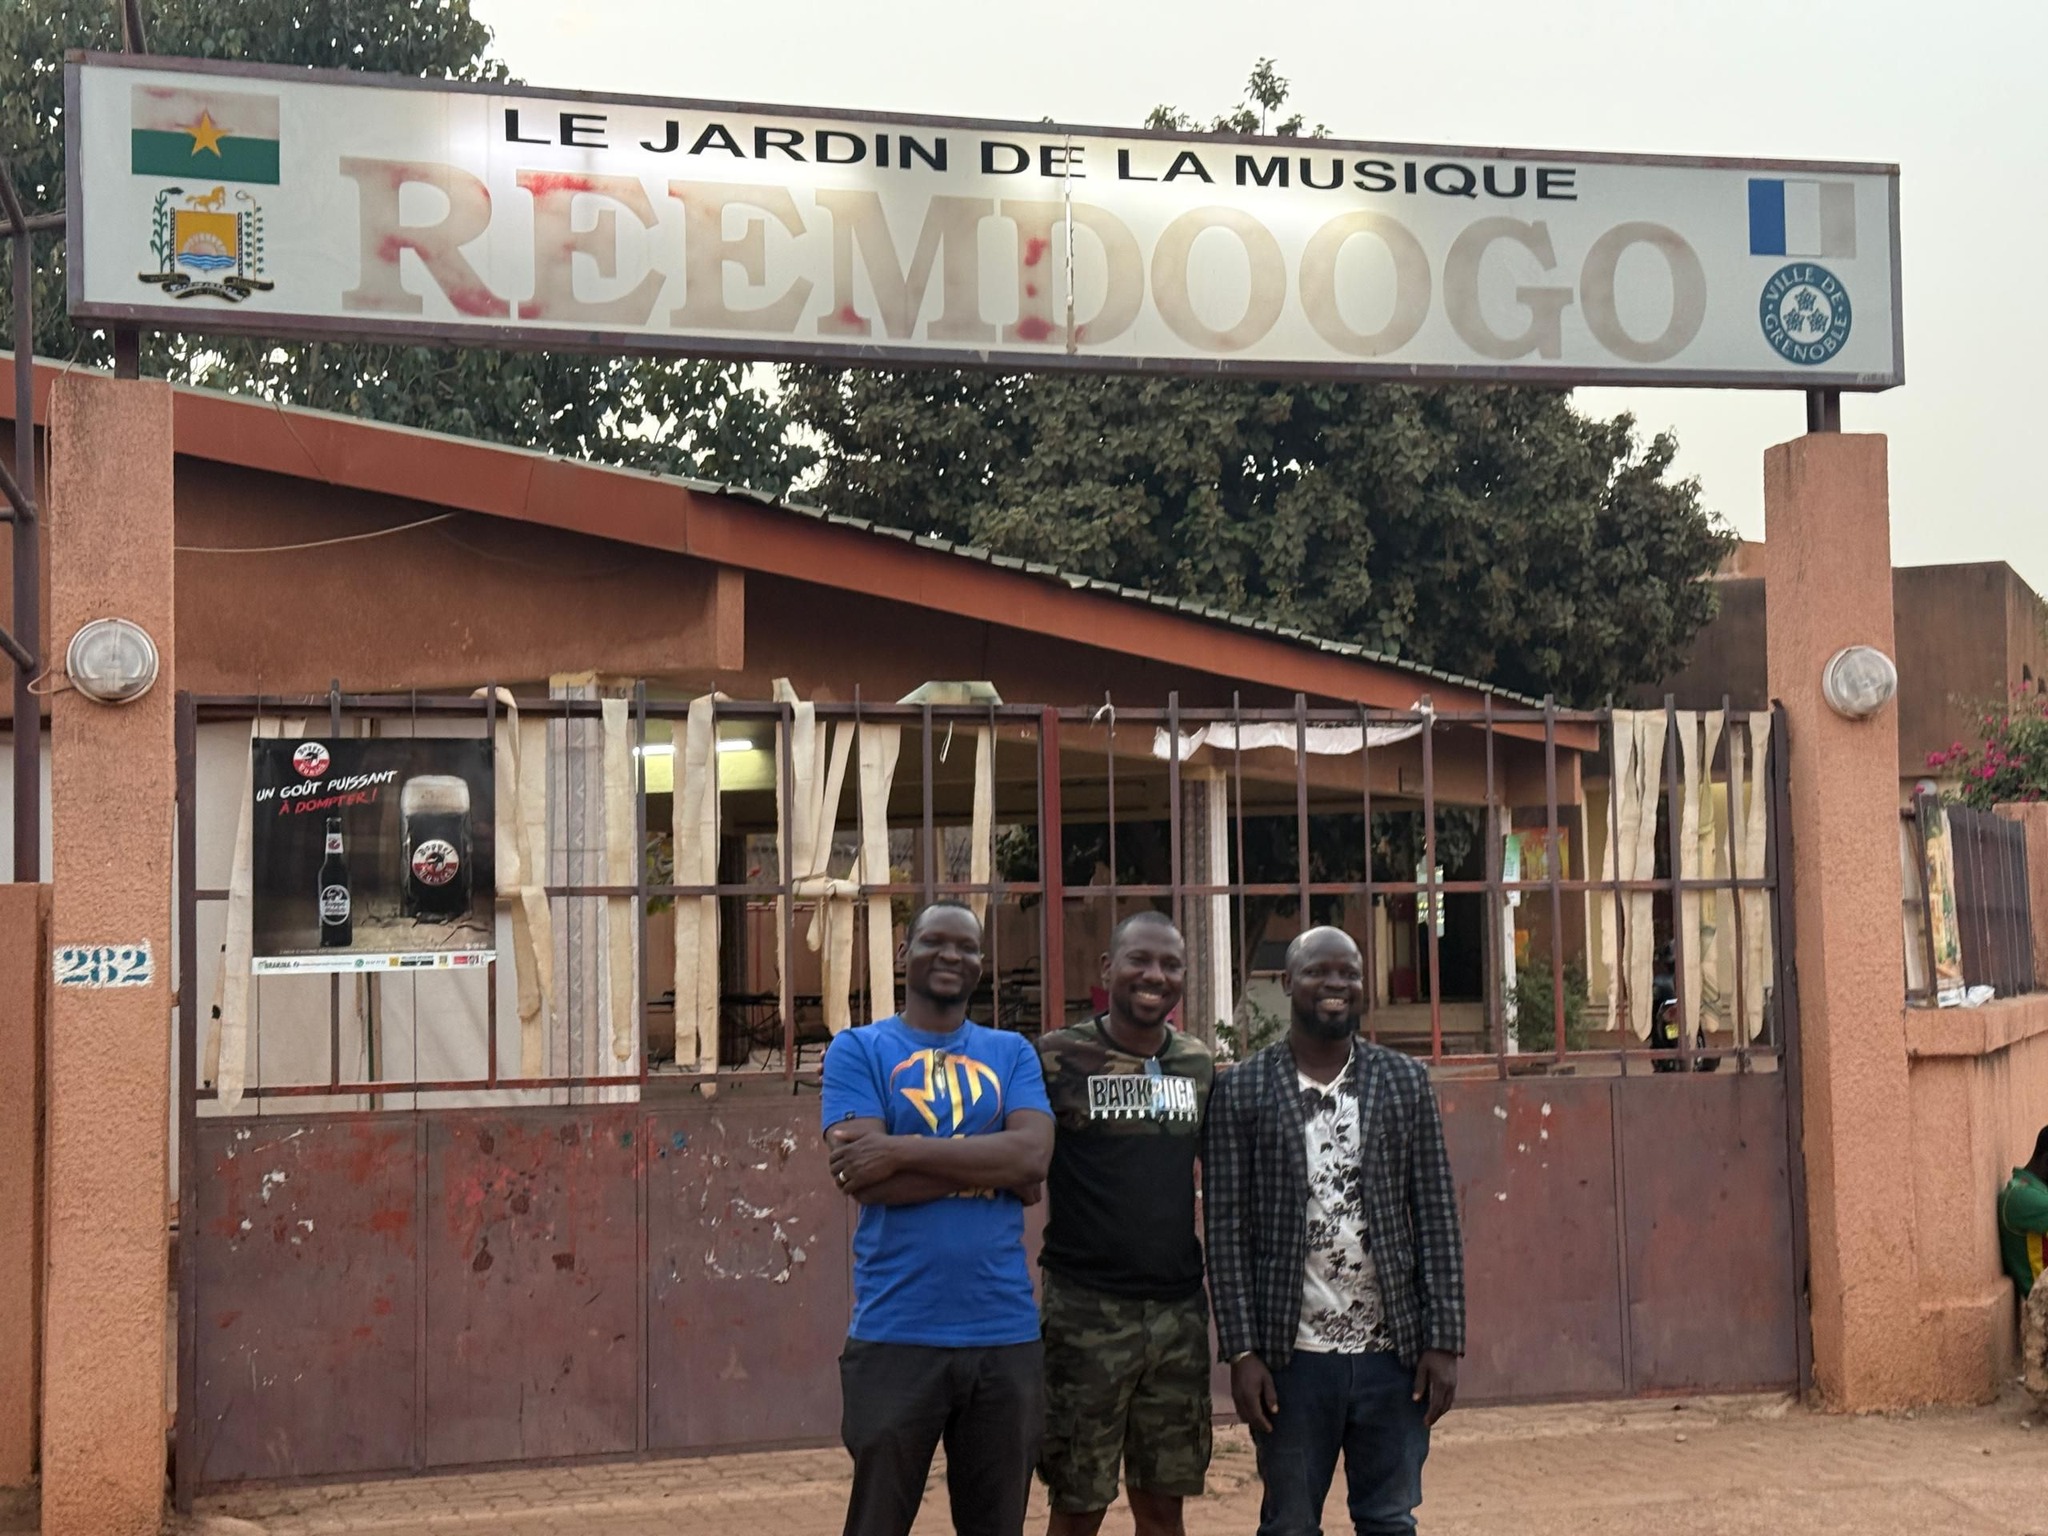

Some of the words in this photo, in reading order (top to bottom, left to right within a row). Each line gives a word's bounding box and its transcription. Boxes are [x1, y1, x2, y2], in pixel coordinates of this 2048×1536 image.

[505, 108, 609, 149] LE
[639, 120, 948, 173] JARDIN
[980, 141, 1087, 179] DE
[1117, 148, 1216, 185] LA
[1235, 154, 1578, 201] MUSIQUE
[339, 155, 1708, 364] REEMDOOGO
[1766, 267, 1814, 300] VILLE
[1821, 276, 1844, 305] DE
[1765, 313, 1848, 362] GRENOBLE
[256, 787, 276, 802] UN
[279, 779, 323, 799] GOÛT
[327, 770, 398, 792] PUISSANT
[279, 799, 290, 815] À
[294, 791, 371, 815] DOMPTER
[62, 948, 149, 984] 282
